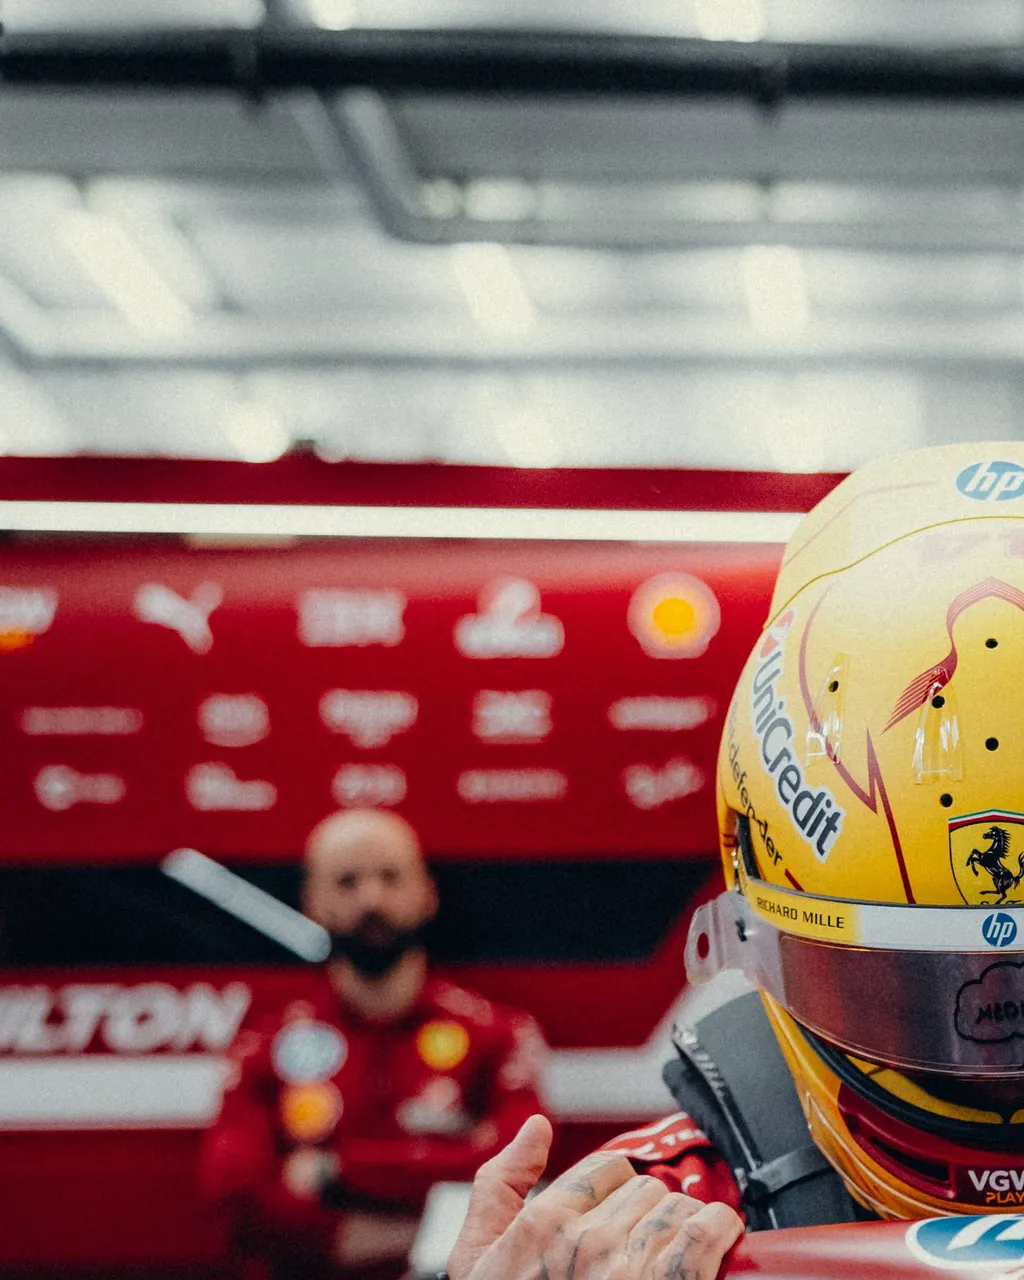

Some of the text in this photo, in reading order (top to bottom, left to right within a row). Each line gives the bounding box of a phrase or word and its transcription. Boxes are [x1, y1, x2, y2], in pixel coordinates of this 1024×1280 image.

[752, 650, 842, 857] UniCredit
[756, 896, 846, 929] RICHARD MILLE
[983, 913, 1016, 948] hp
